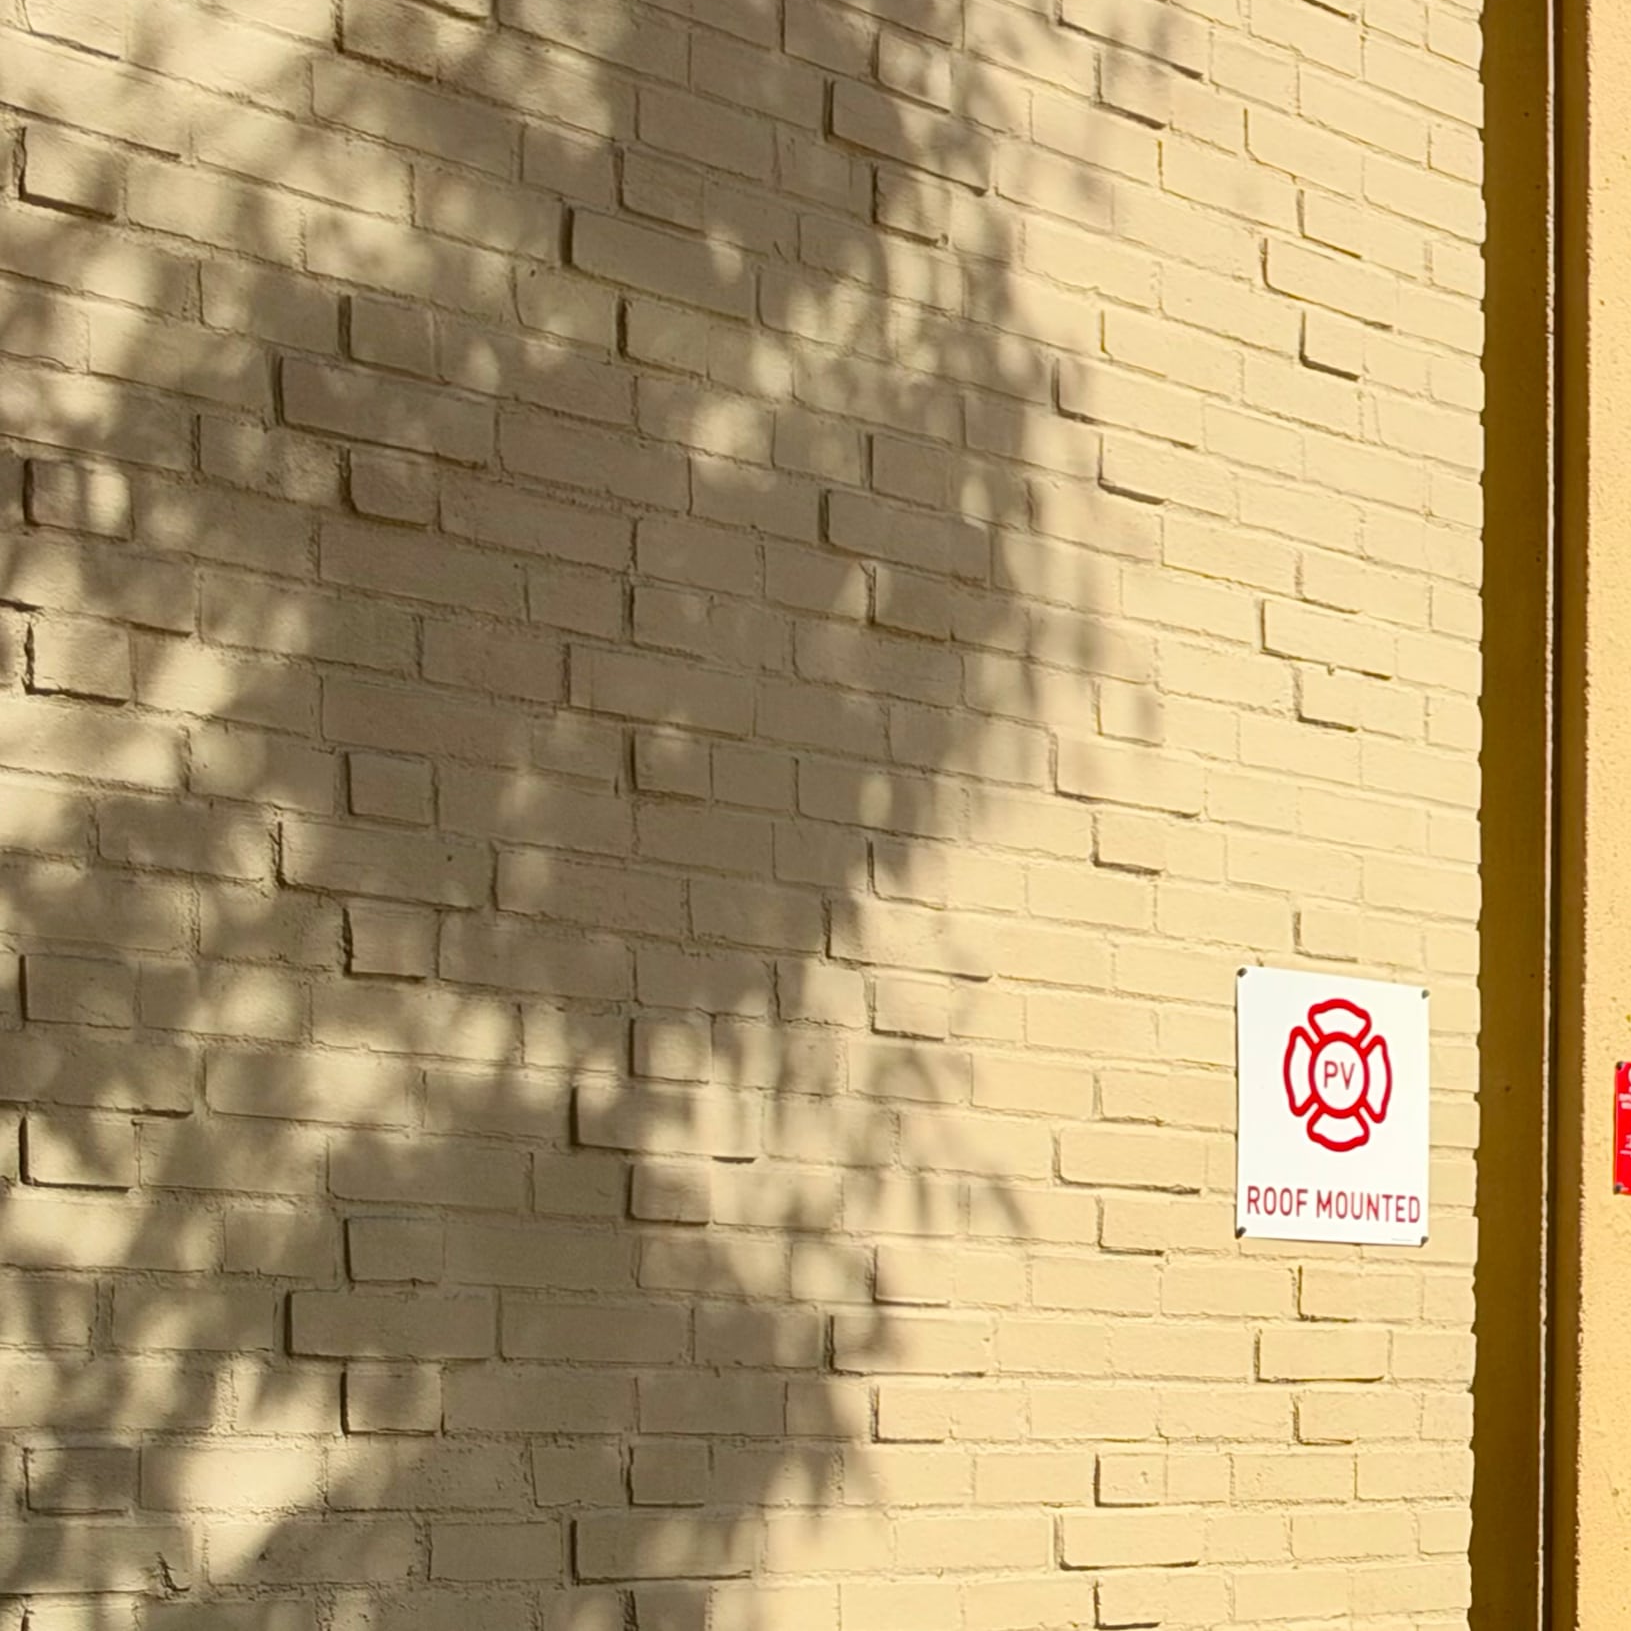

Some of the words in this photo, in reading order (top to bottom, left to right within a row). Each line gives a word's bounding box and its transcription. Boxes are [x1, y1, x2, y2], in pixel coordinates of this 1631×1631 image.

[1324, 1060, 1356, 1090] PV
[1247, 1185, 1309, 1217] ROOF
[1316, 1189, 1421, 1223] MOUNTED
